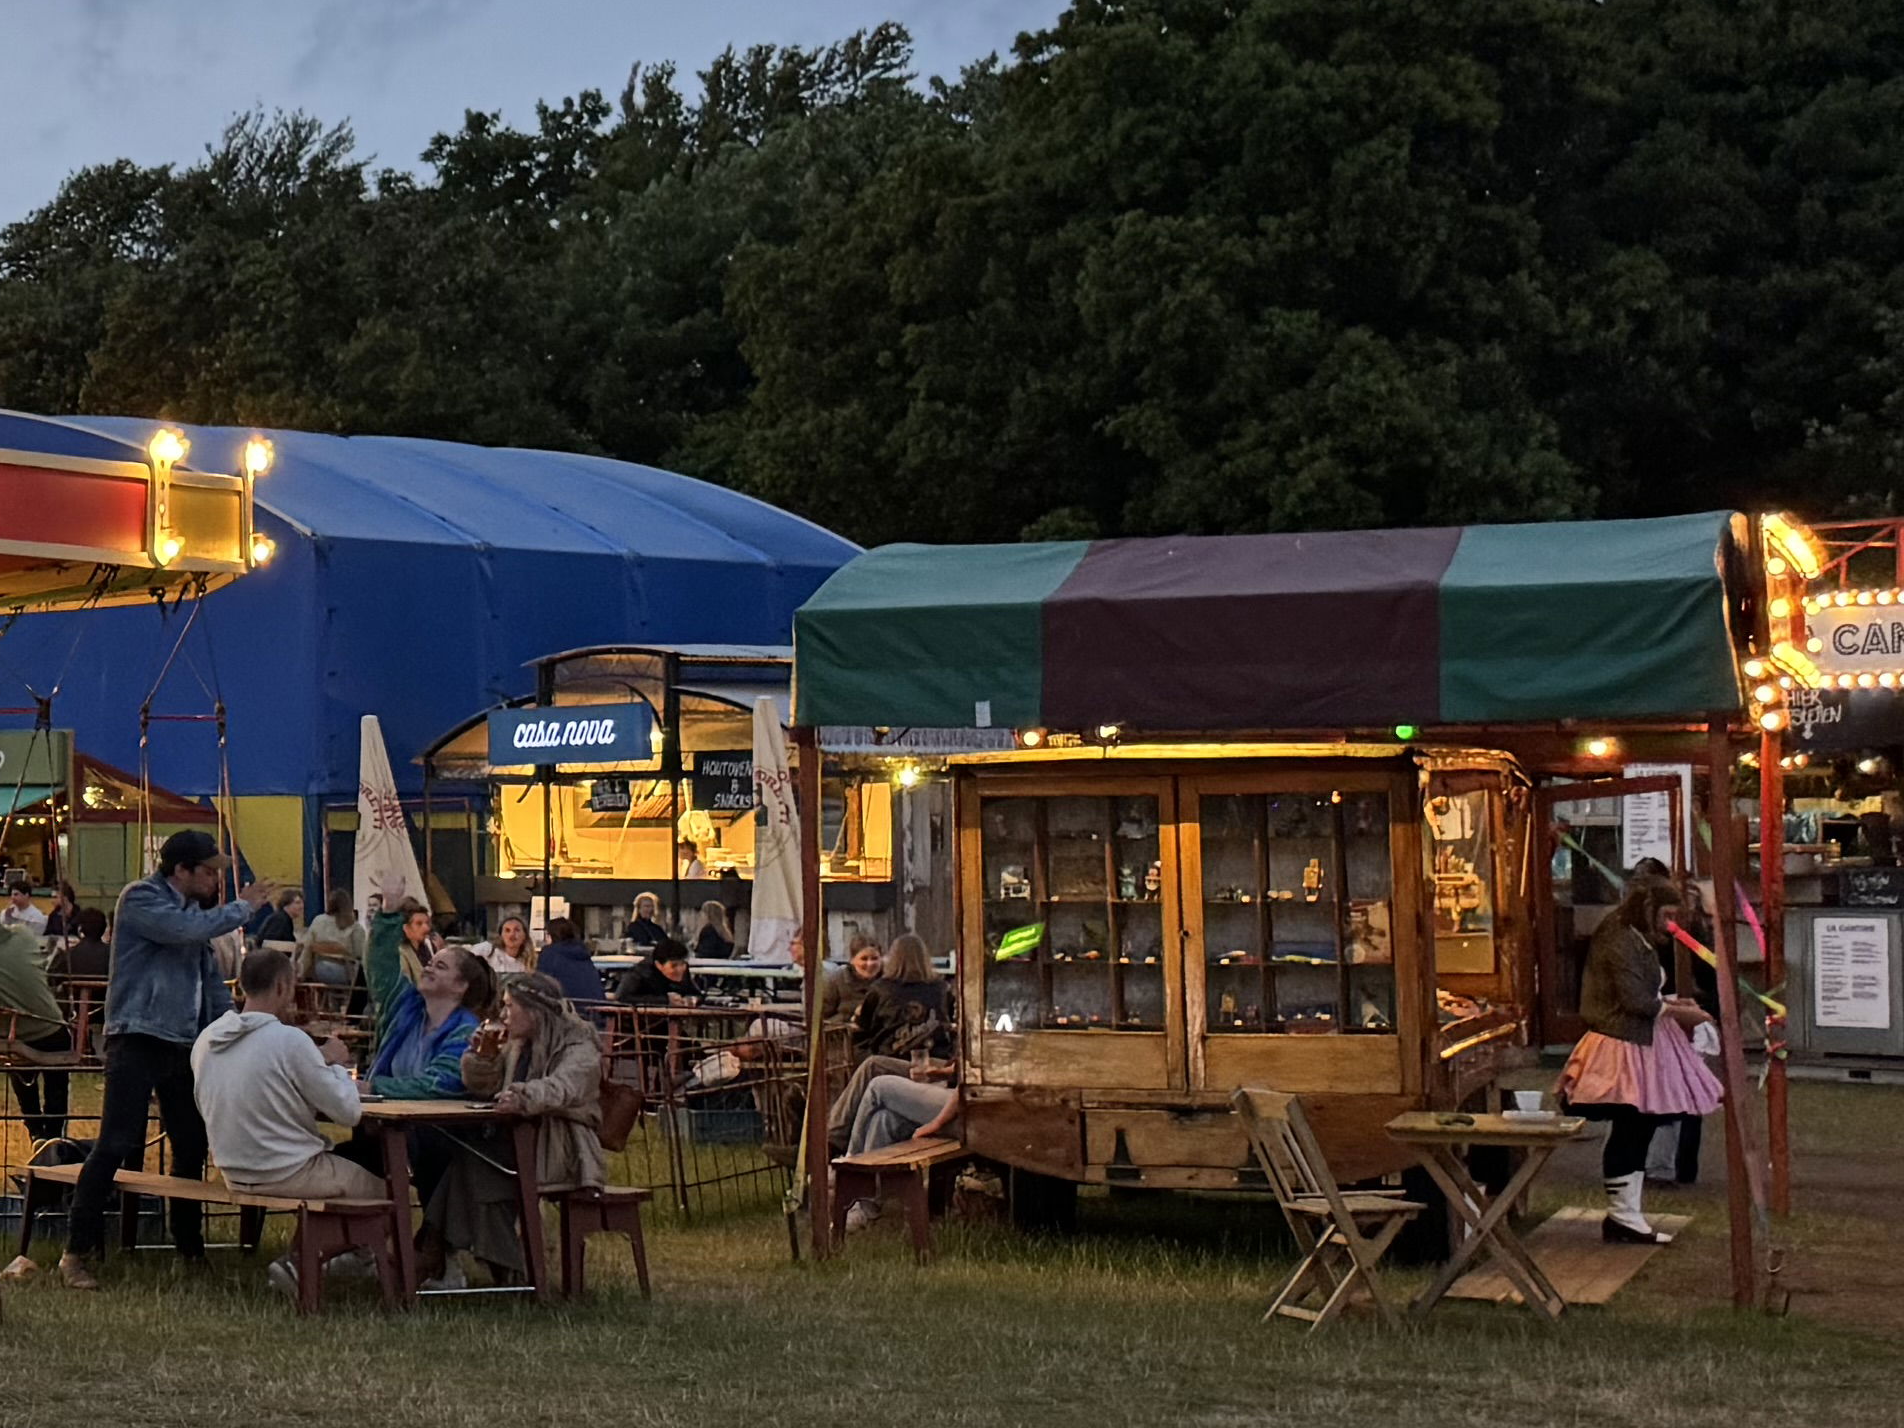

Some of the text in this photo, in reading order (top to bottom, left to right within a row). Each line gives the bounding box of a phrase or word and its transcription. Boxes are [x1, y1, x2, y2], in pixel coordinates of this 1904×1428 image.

[513, 719, 616, 748] casa nova
[702, 760, 753, 777] HOUTOVEN
[713, 793, 752, 809] SNACKS
